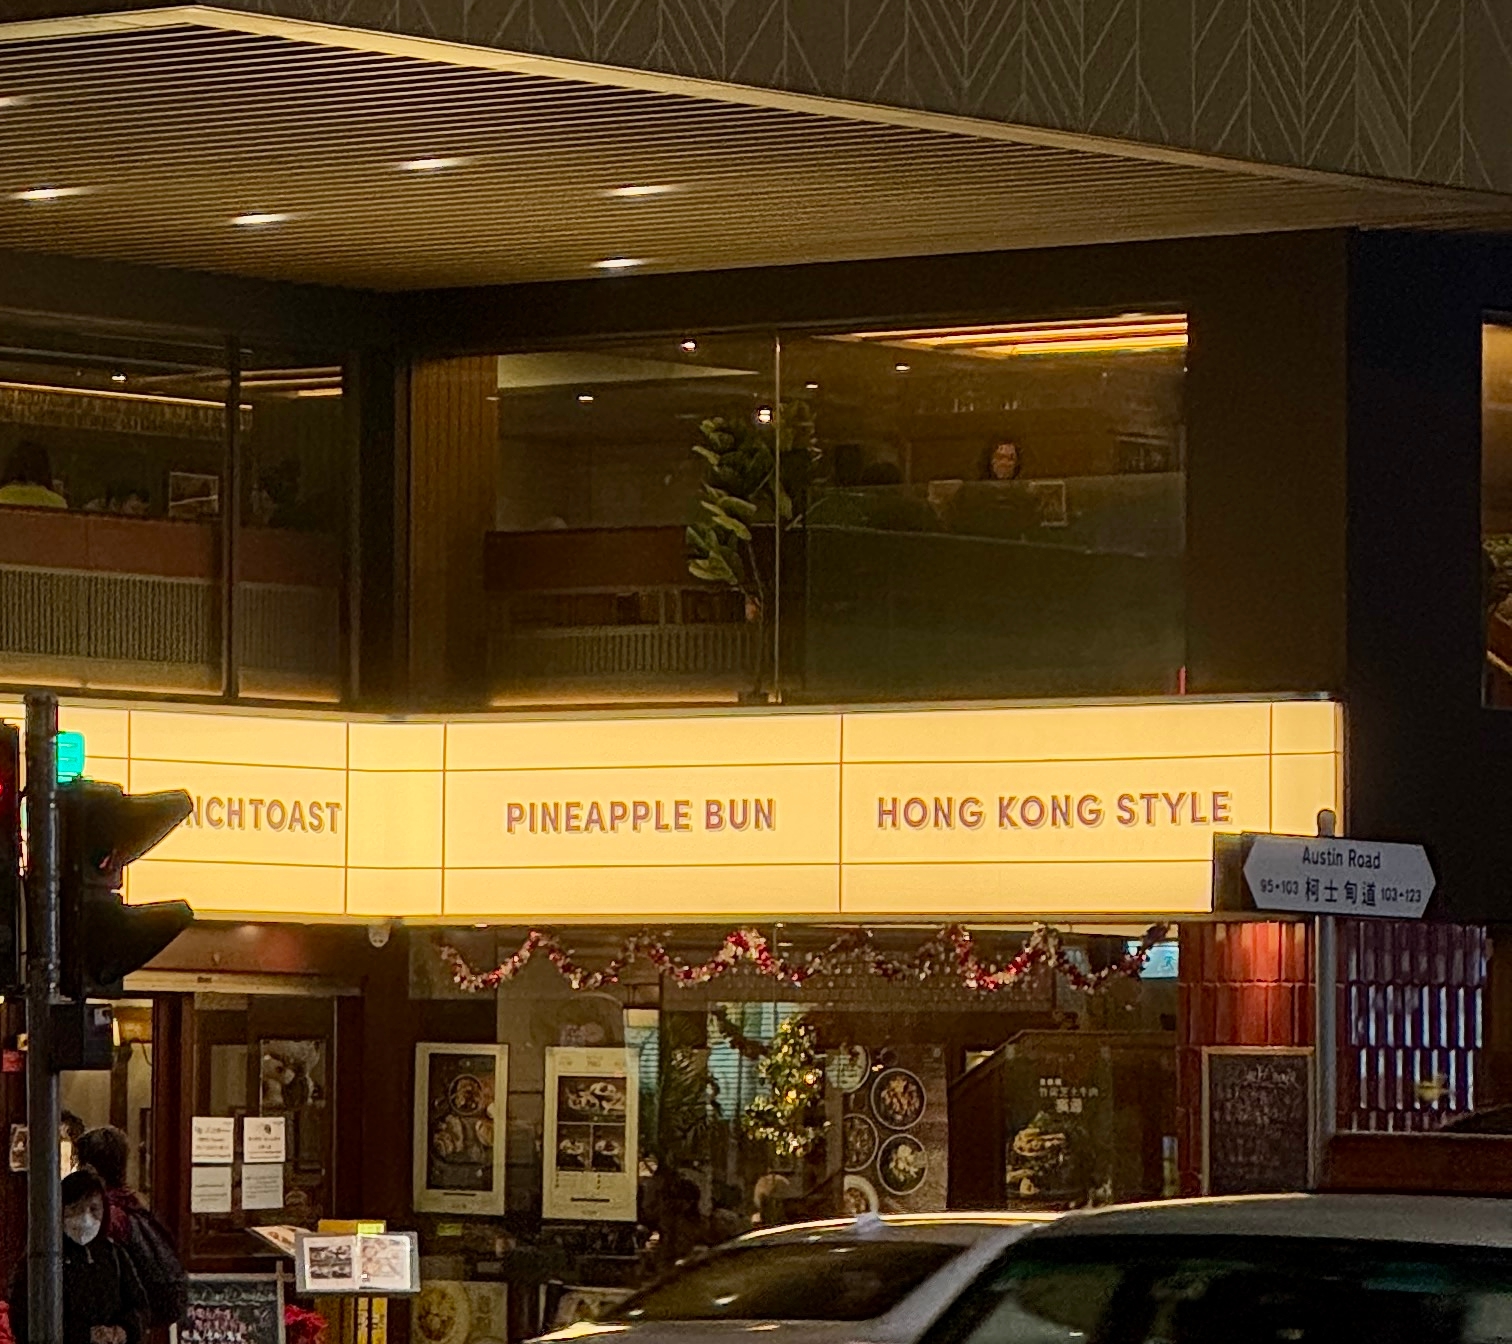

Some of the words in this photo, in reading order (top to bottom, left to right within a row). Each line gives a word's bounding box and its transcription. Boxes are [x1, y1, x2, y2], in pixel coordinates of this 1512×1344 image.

[505, 799, 692, 835] PINEAPPLE
[704, 798, 776, 831] BUN
[878, 796, 985, 830] HONG
[998, 794, 1103, 828] KONG
[1116, 790, 1232, 826] STYLE
[1302, 846, 1344, 867] Austin
[1348, 849, 1381, 870] Road
[1305, 876, 1377, 907] 柯士甸道
